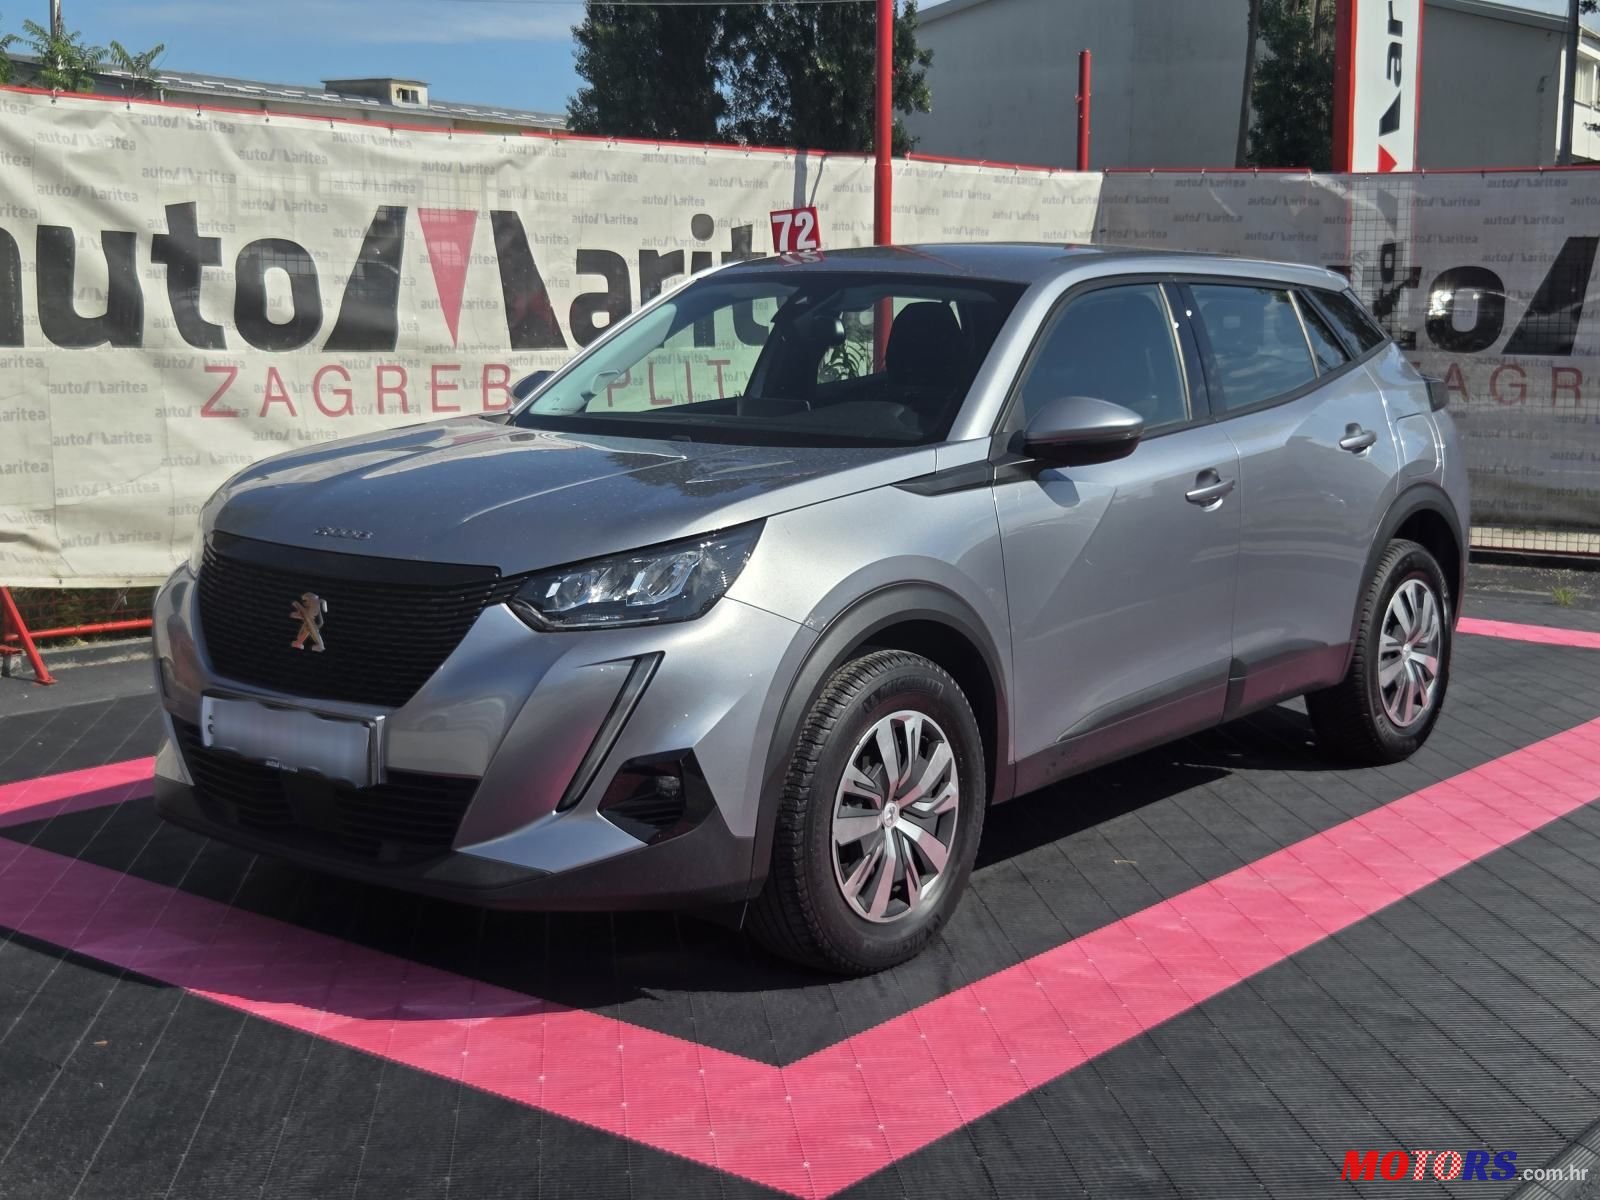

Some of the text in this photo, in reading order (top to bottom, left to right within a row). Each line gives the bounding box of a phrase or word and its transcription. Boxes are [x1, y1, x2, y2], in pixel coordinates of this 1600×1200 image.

[771, 210, 817, 253] 72
[200, 362, 512, 419] ZAGREB
[606, 358, 731, 408] PLIT
[1411, 361, 1583, 408] AGR
